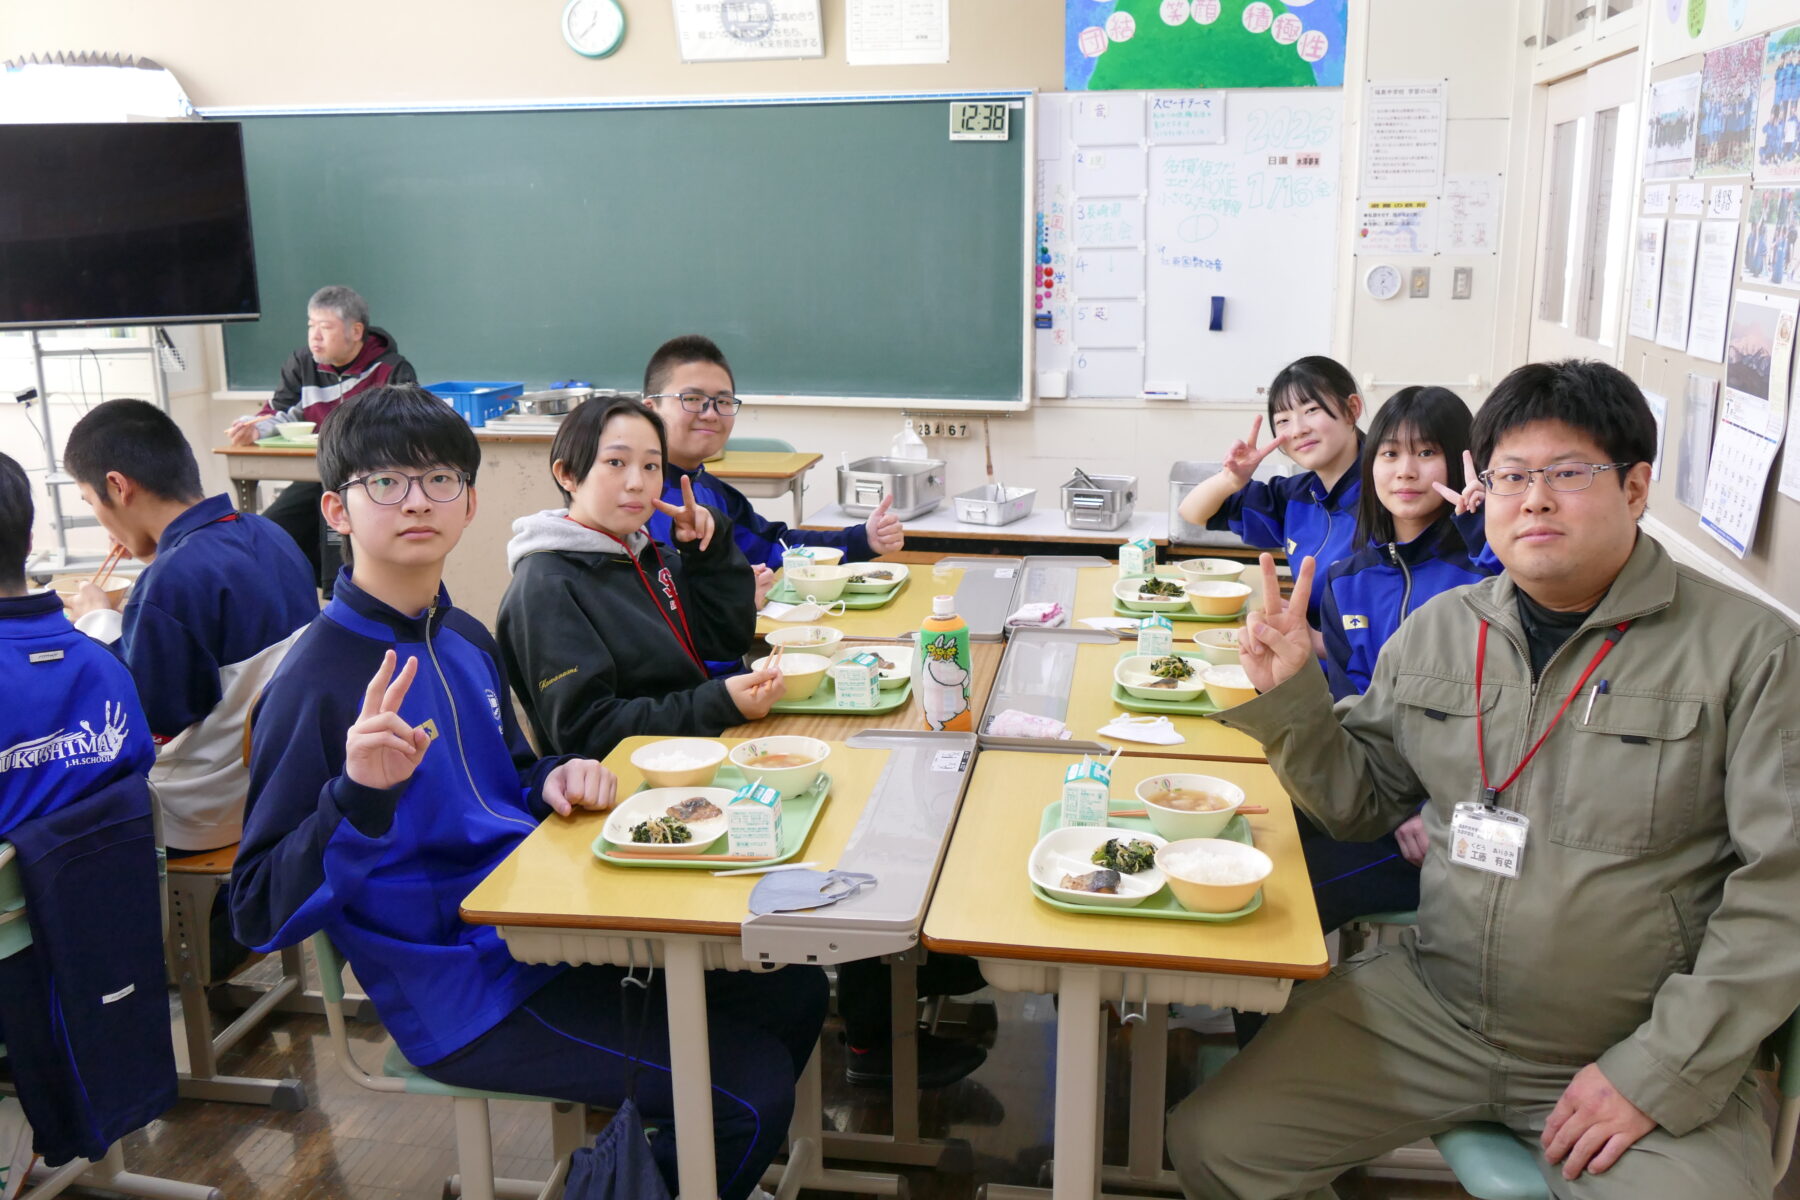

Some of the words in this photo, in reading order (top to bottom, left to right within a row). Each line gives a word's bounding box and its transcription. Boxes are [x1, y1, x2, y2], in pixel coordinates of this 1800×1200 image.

[1079, 14, 1135, 58] 団結
[1244, 5, 1326, 60] 積極性
[961, 104, 1005, 130] 12:38
[1244, 105, 1335, 155] 2026
[1077, 153, 1084, 163] 2
[1077, 204, 1085, 220] 3
[1076, 257, 1088, 273] 4
[1078, 307, 1088, 320] 5
[1078, 355, 1087, 369] 6
[1495, 857, 1513, 869] 有史
